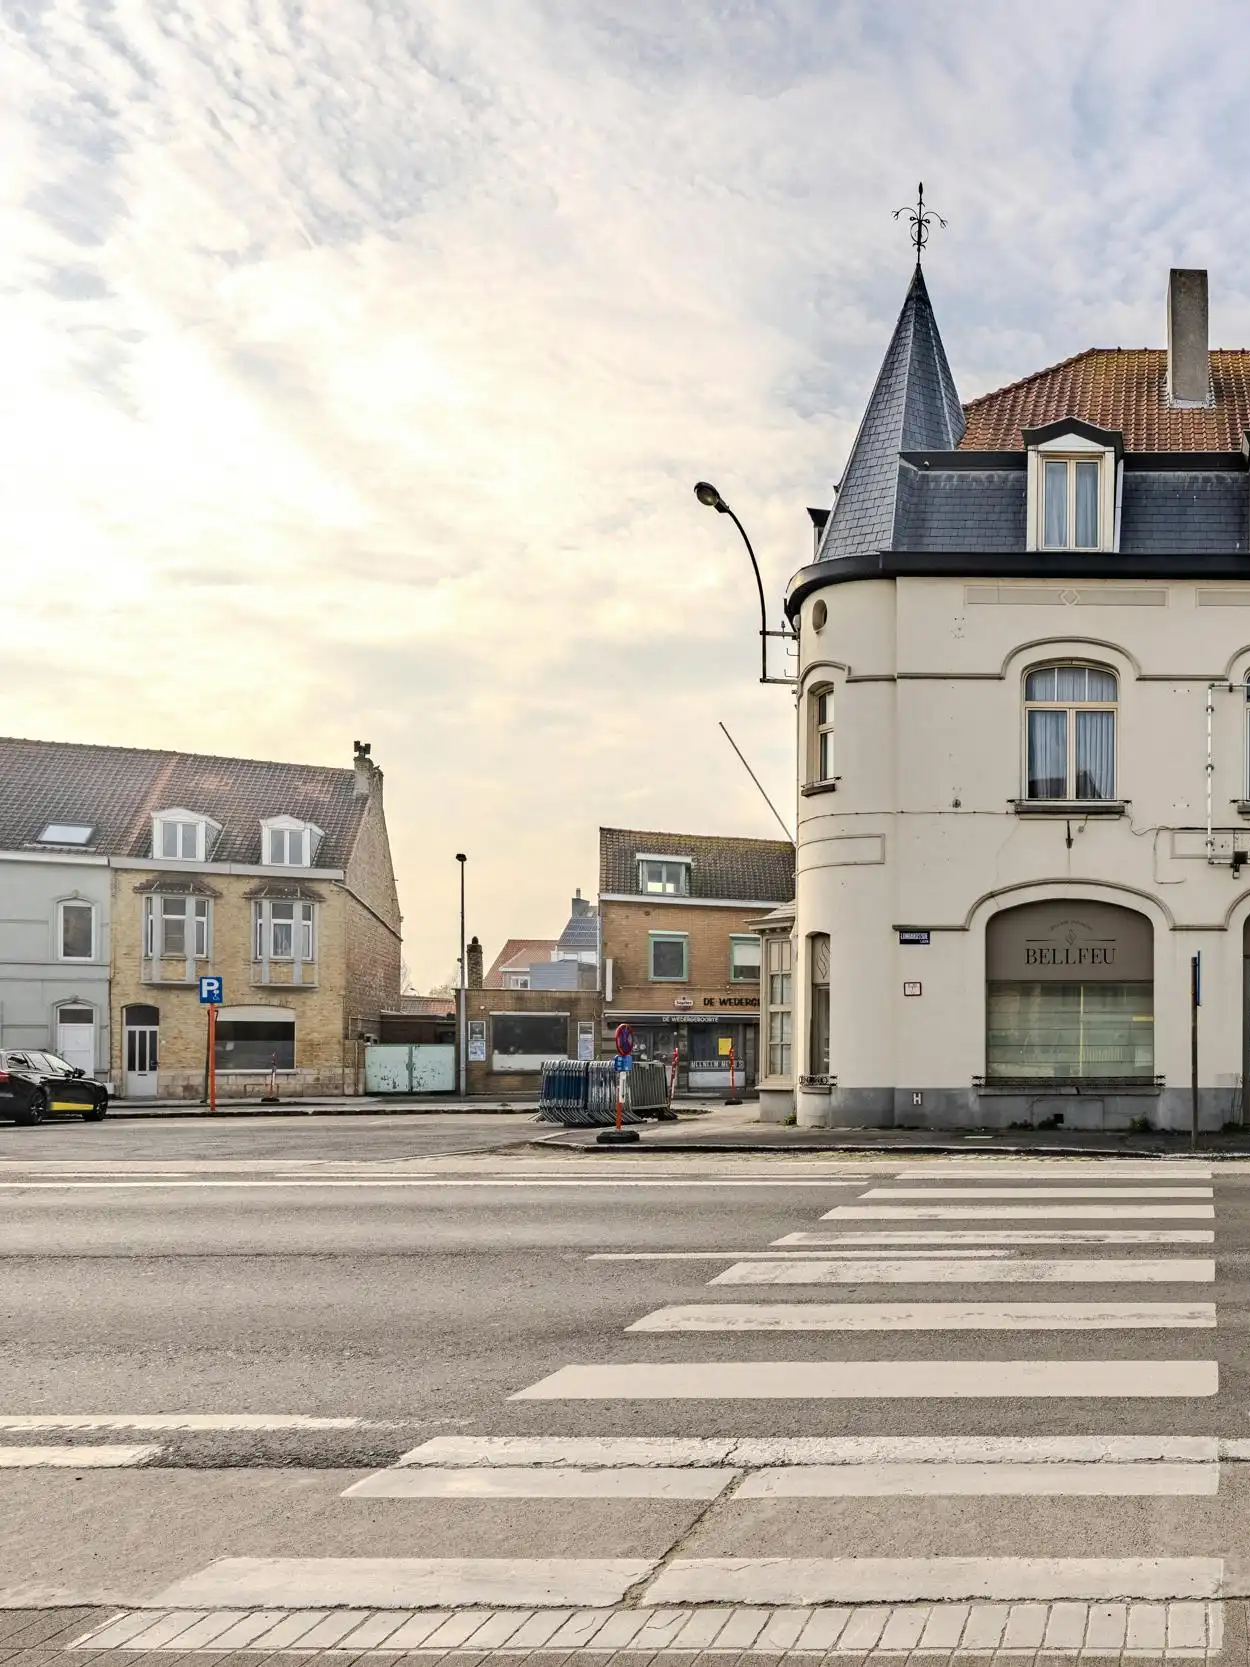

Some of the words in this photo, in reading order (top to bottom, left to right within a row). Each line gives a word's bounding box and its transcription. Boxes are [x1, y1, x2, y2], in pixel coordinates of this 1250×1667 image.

[1025, 947, 1116, 966] BELLFEU
[201, 978, 219, 998] P
[703, 997, 715, 1007] DE
[913, 1092, 922, 1105] H
